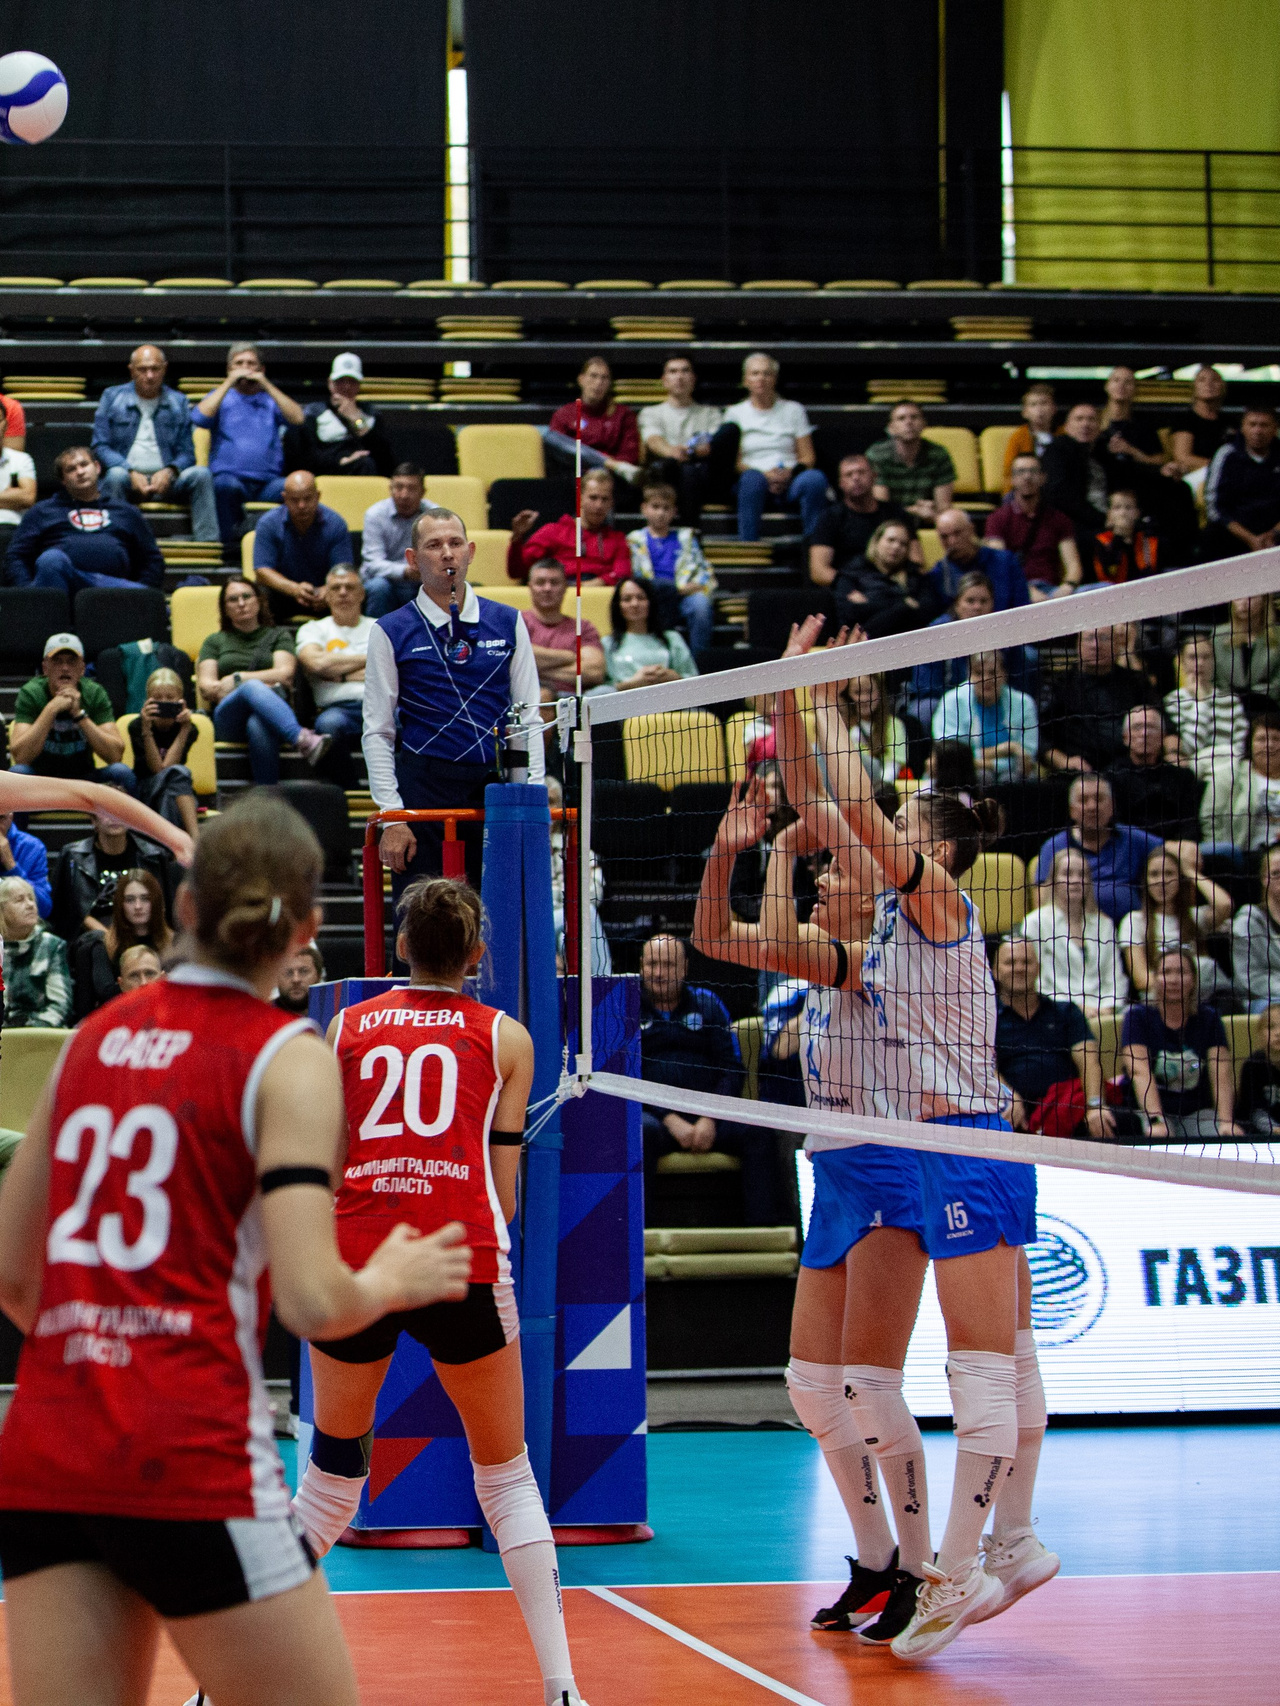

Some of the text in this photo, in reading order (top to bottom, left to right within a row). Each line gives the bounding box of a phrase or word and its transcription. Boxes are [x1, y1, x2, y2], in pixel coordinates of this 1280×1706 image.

[358, 1008, 466, 1033] КУПРЕЕВА
[358, 1043, 459, 1142] 20
[344, 1156, 470, 1181] КАЛИНИНГРАДСКАЯ
[46, 1103, 180, 1273] 23
[372, 1176, 434, 1195] ОБЛАСТЬ
[943, 1201, 969, 1231] 15
[982, 1456, 1003, 1493] adrenalin
